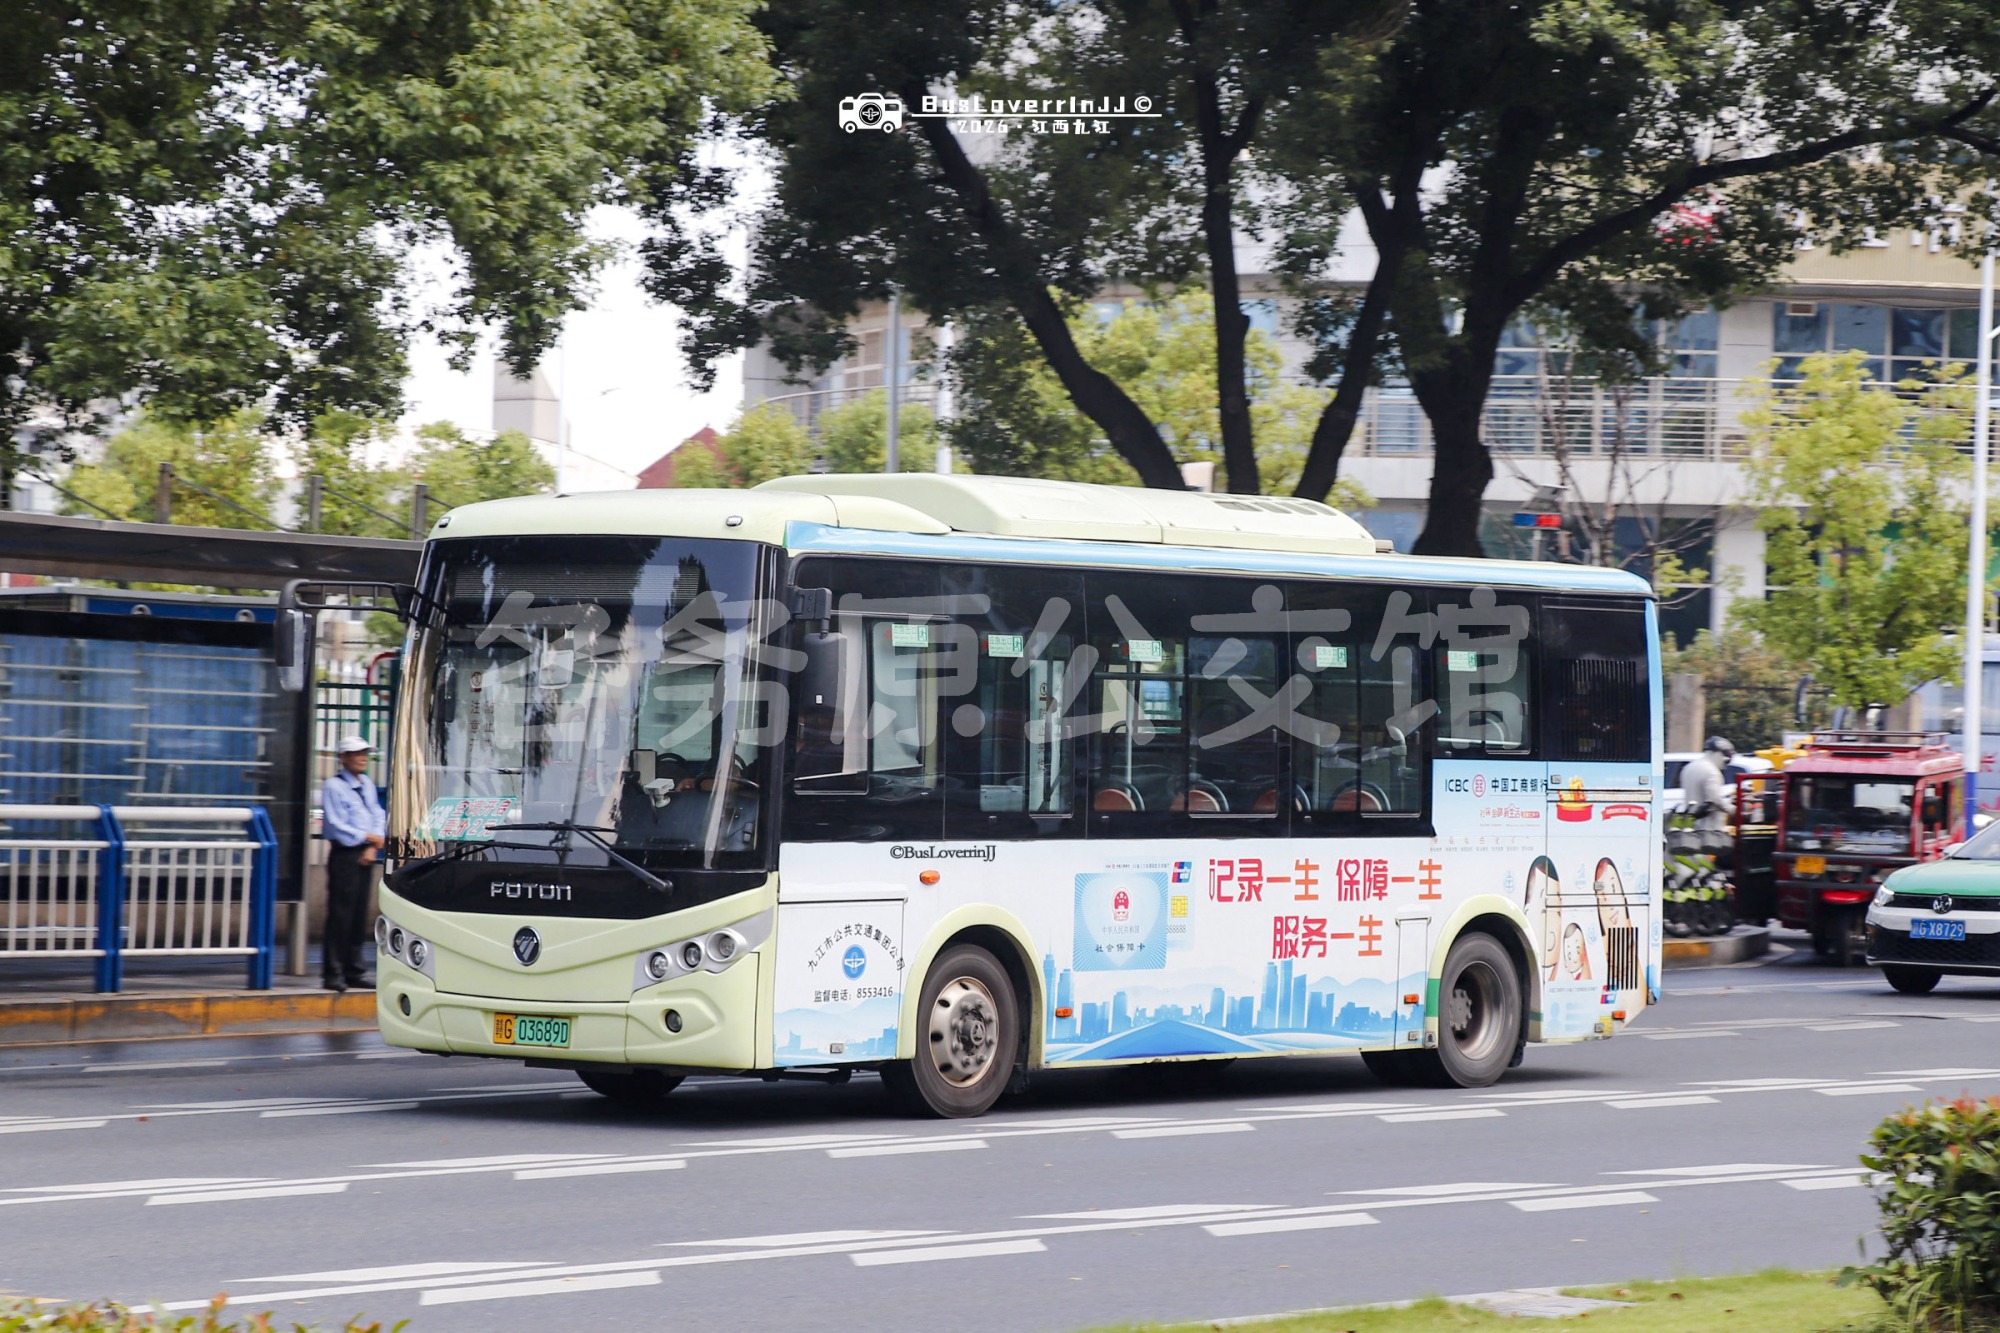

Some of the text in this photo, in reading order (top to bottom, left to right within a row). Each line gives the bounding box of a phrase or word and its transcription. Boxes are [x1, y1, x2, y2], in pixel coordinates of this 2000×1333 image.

[1445, 778, 1548, 792] ICBC 中国工商银行
[1209, 858, 1320, 902] 记录一生
[1336, 858, 1442, 901] 保障一生
[490, 881, 572, 901] FOTON
[1101, 925, 1140, 935] 中华人民共和国
[1272, 914, 1383, 959] 服务一生
[808, 923, 906, 972] 九江市公共交通集团公司
[1095, 943, 1146, 953] 社会保障卡
